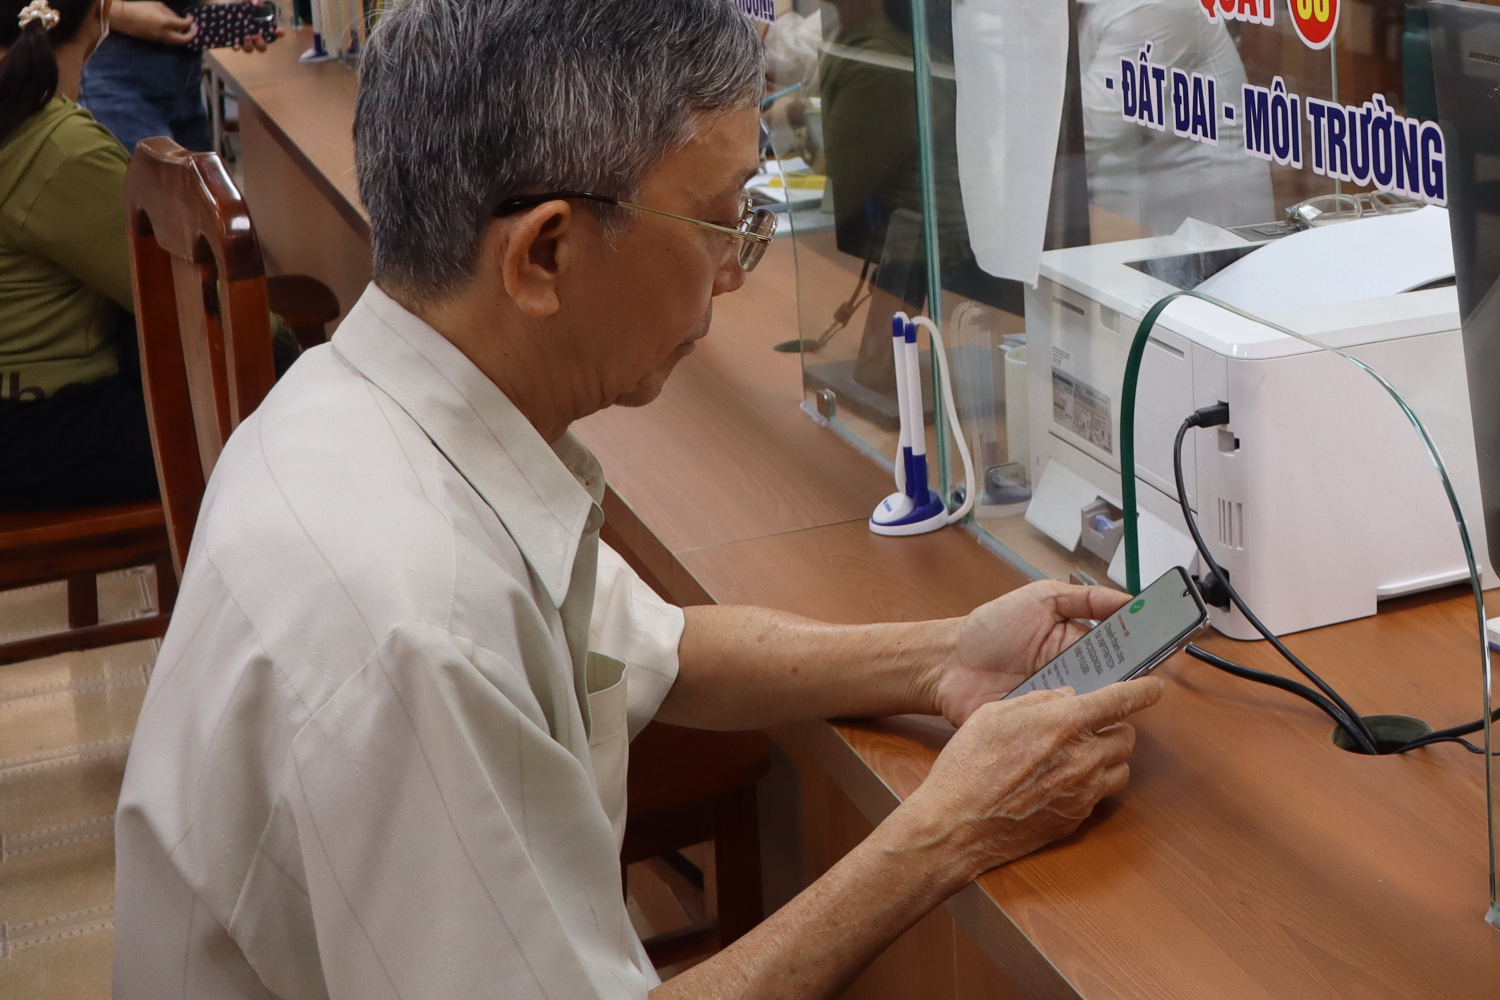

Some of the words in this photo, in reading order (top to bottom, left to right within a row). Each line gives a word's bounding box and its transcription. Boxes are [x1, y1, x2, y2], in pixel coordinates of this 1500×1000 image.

[1122, 42, 1166, 126] ĐẤT
[1174, 71, 1217, 142] ĐAI
[1245, 78, 1302, 165] MÔI
[1309, 97, 1446, 202] TRƯỜNG
